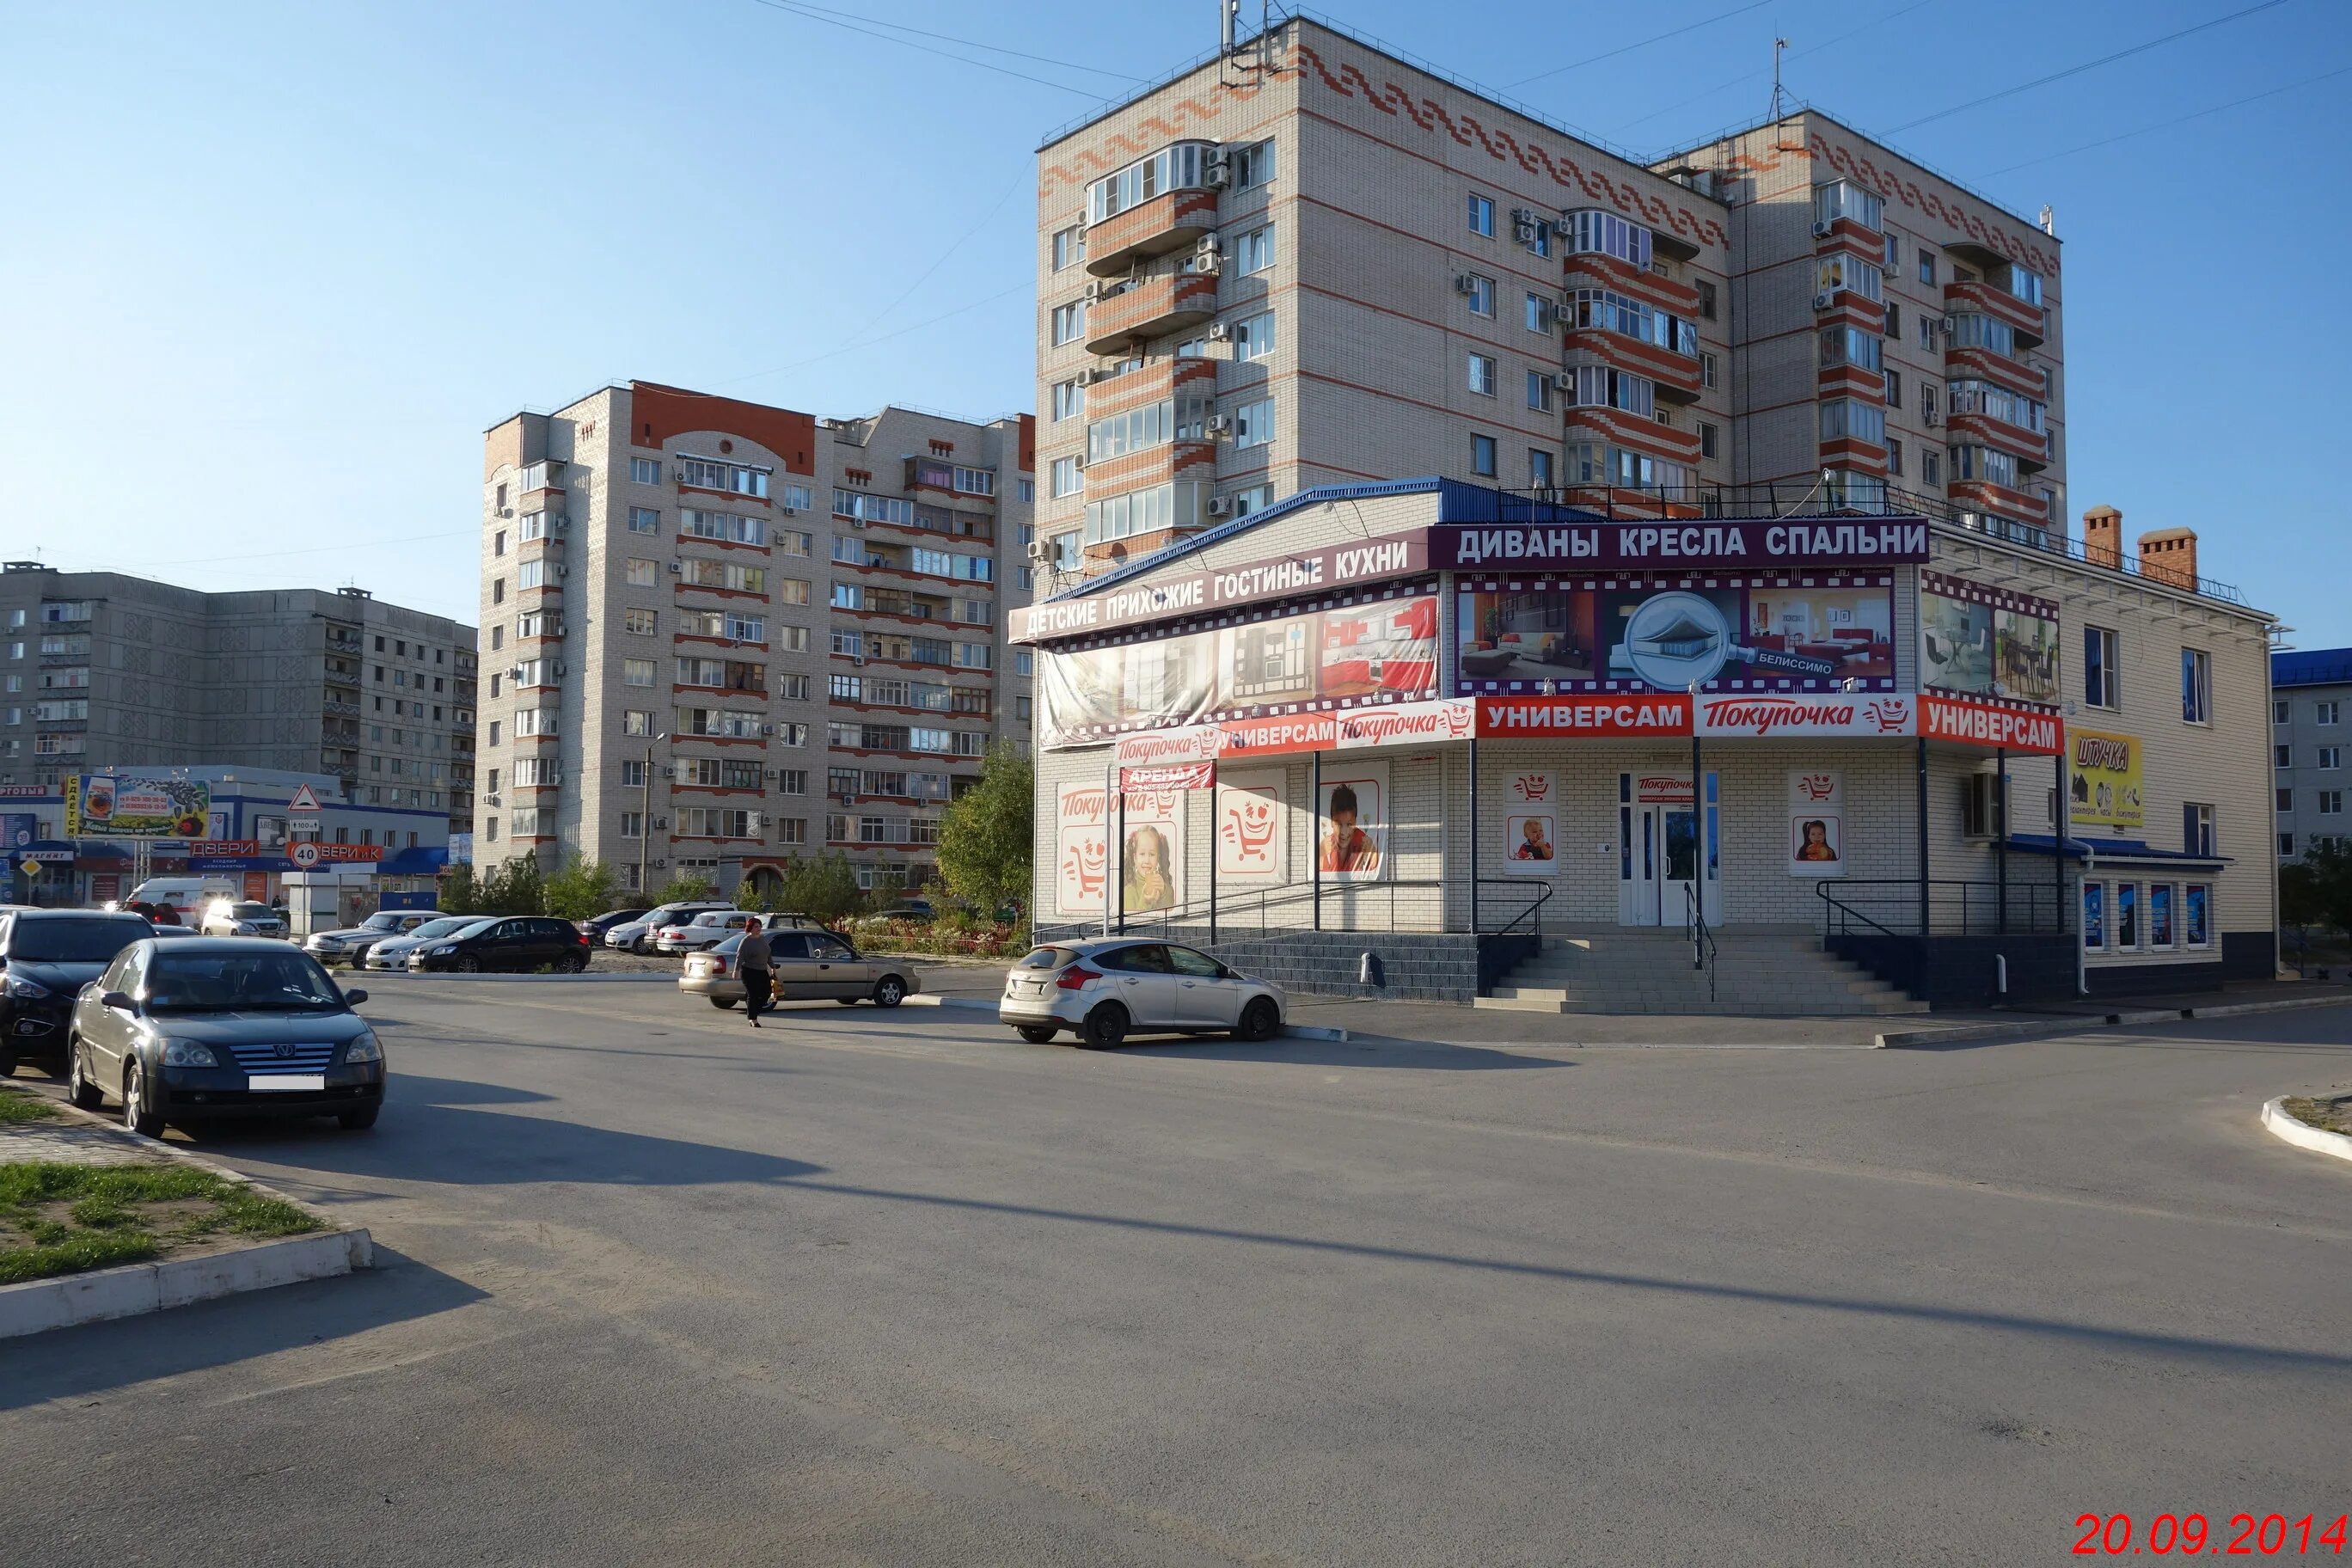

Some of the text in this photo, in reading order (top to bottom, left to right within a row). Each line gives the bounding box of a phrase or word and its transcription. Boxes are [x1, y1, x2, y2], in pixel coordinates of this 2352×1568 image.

[1457, 524, 1926, 564] ДИВАНЫ КРЕСЛА СПАЛЬНИ
[1026, 540, 1408, 638] ДЕТСКИЕ ПРИХОЖИЕ ГОСТИНЫЕ КУХНИ
[1758, 652, 1833, 675] БЕЛИССИМО
[1221, 711, 1438, 750] УНИВЕРСАМ Покупочка
[1487, 697, 1855, 736] УНИВЕРСАМ Покупочка
[1927, 702, 2056, 749] УНИВЕРСАМ
[1118, 735, 1193, 764] Покупочка
[2077, 737, 2128, 771] ШТУЧКА
[1129, 766, 1198, 784] АРЕНДА
[1638, 777, 1694, 793] Покупочк
[192, 842, 254, 856] ДВЕРИ
[297, 848, 315, 861] 40
[316, 845, 358, 859] ВЕРИ
